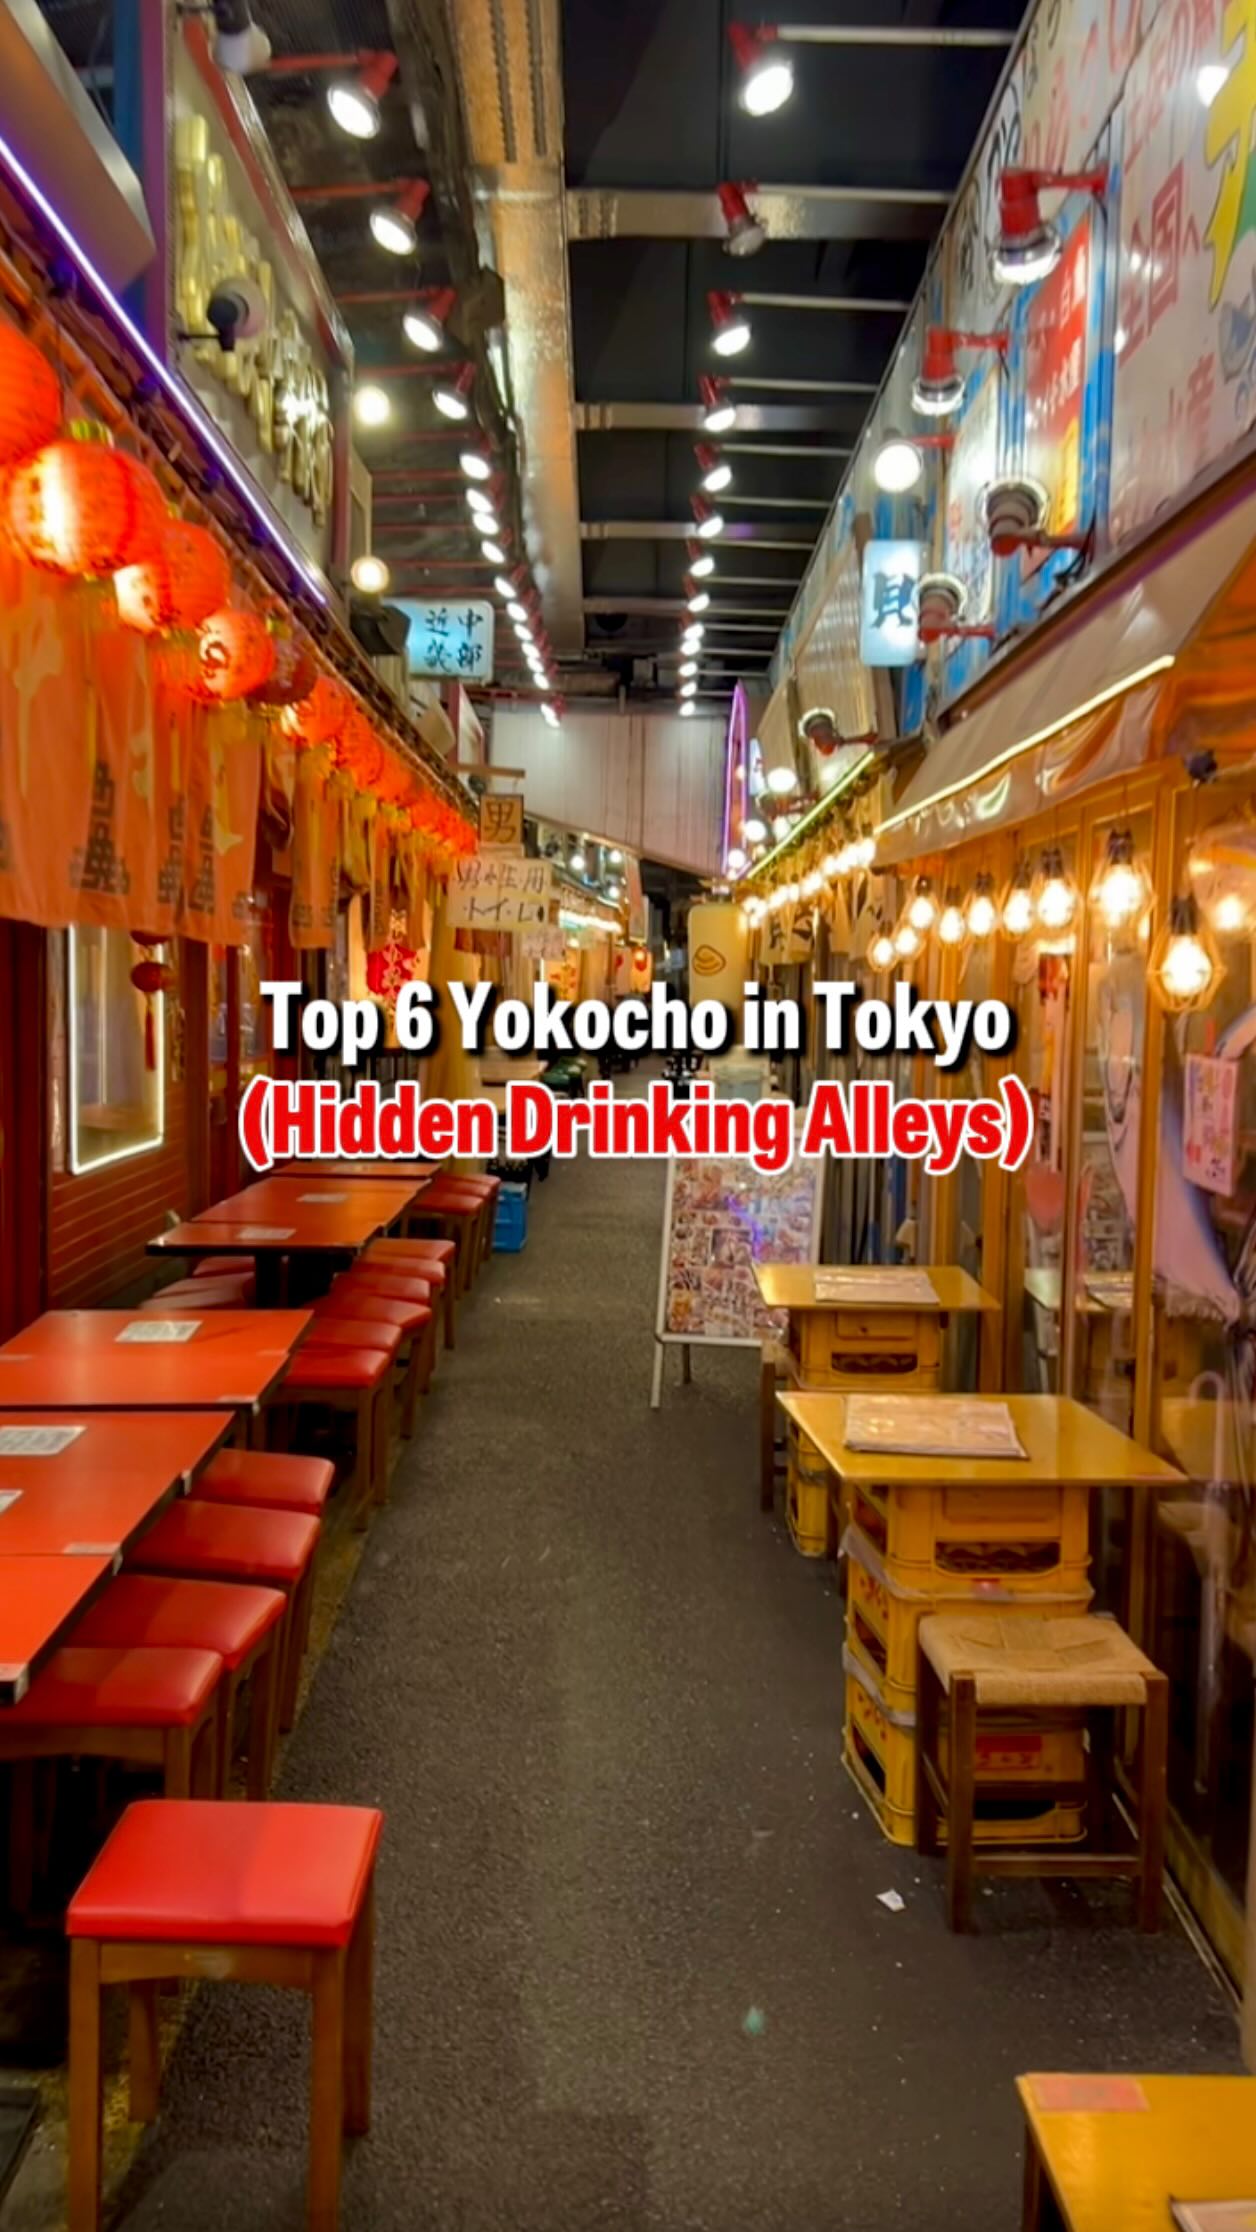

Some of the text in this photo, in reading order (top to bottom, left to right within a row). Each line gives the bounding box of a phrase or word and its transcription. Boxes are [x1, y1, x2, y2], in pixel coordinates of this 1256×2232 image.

[871, 571, 916, 628] 貝
[483, 801, 517, 844] 男
[468, 896, 534, 923] トイレ
